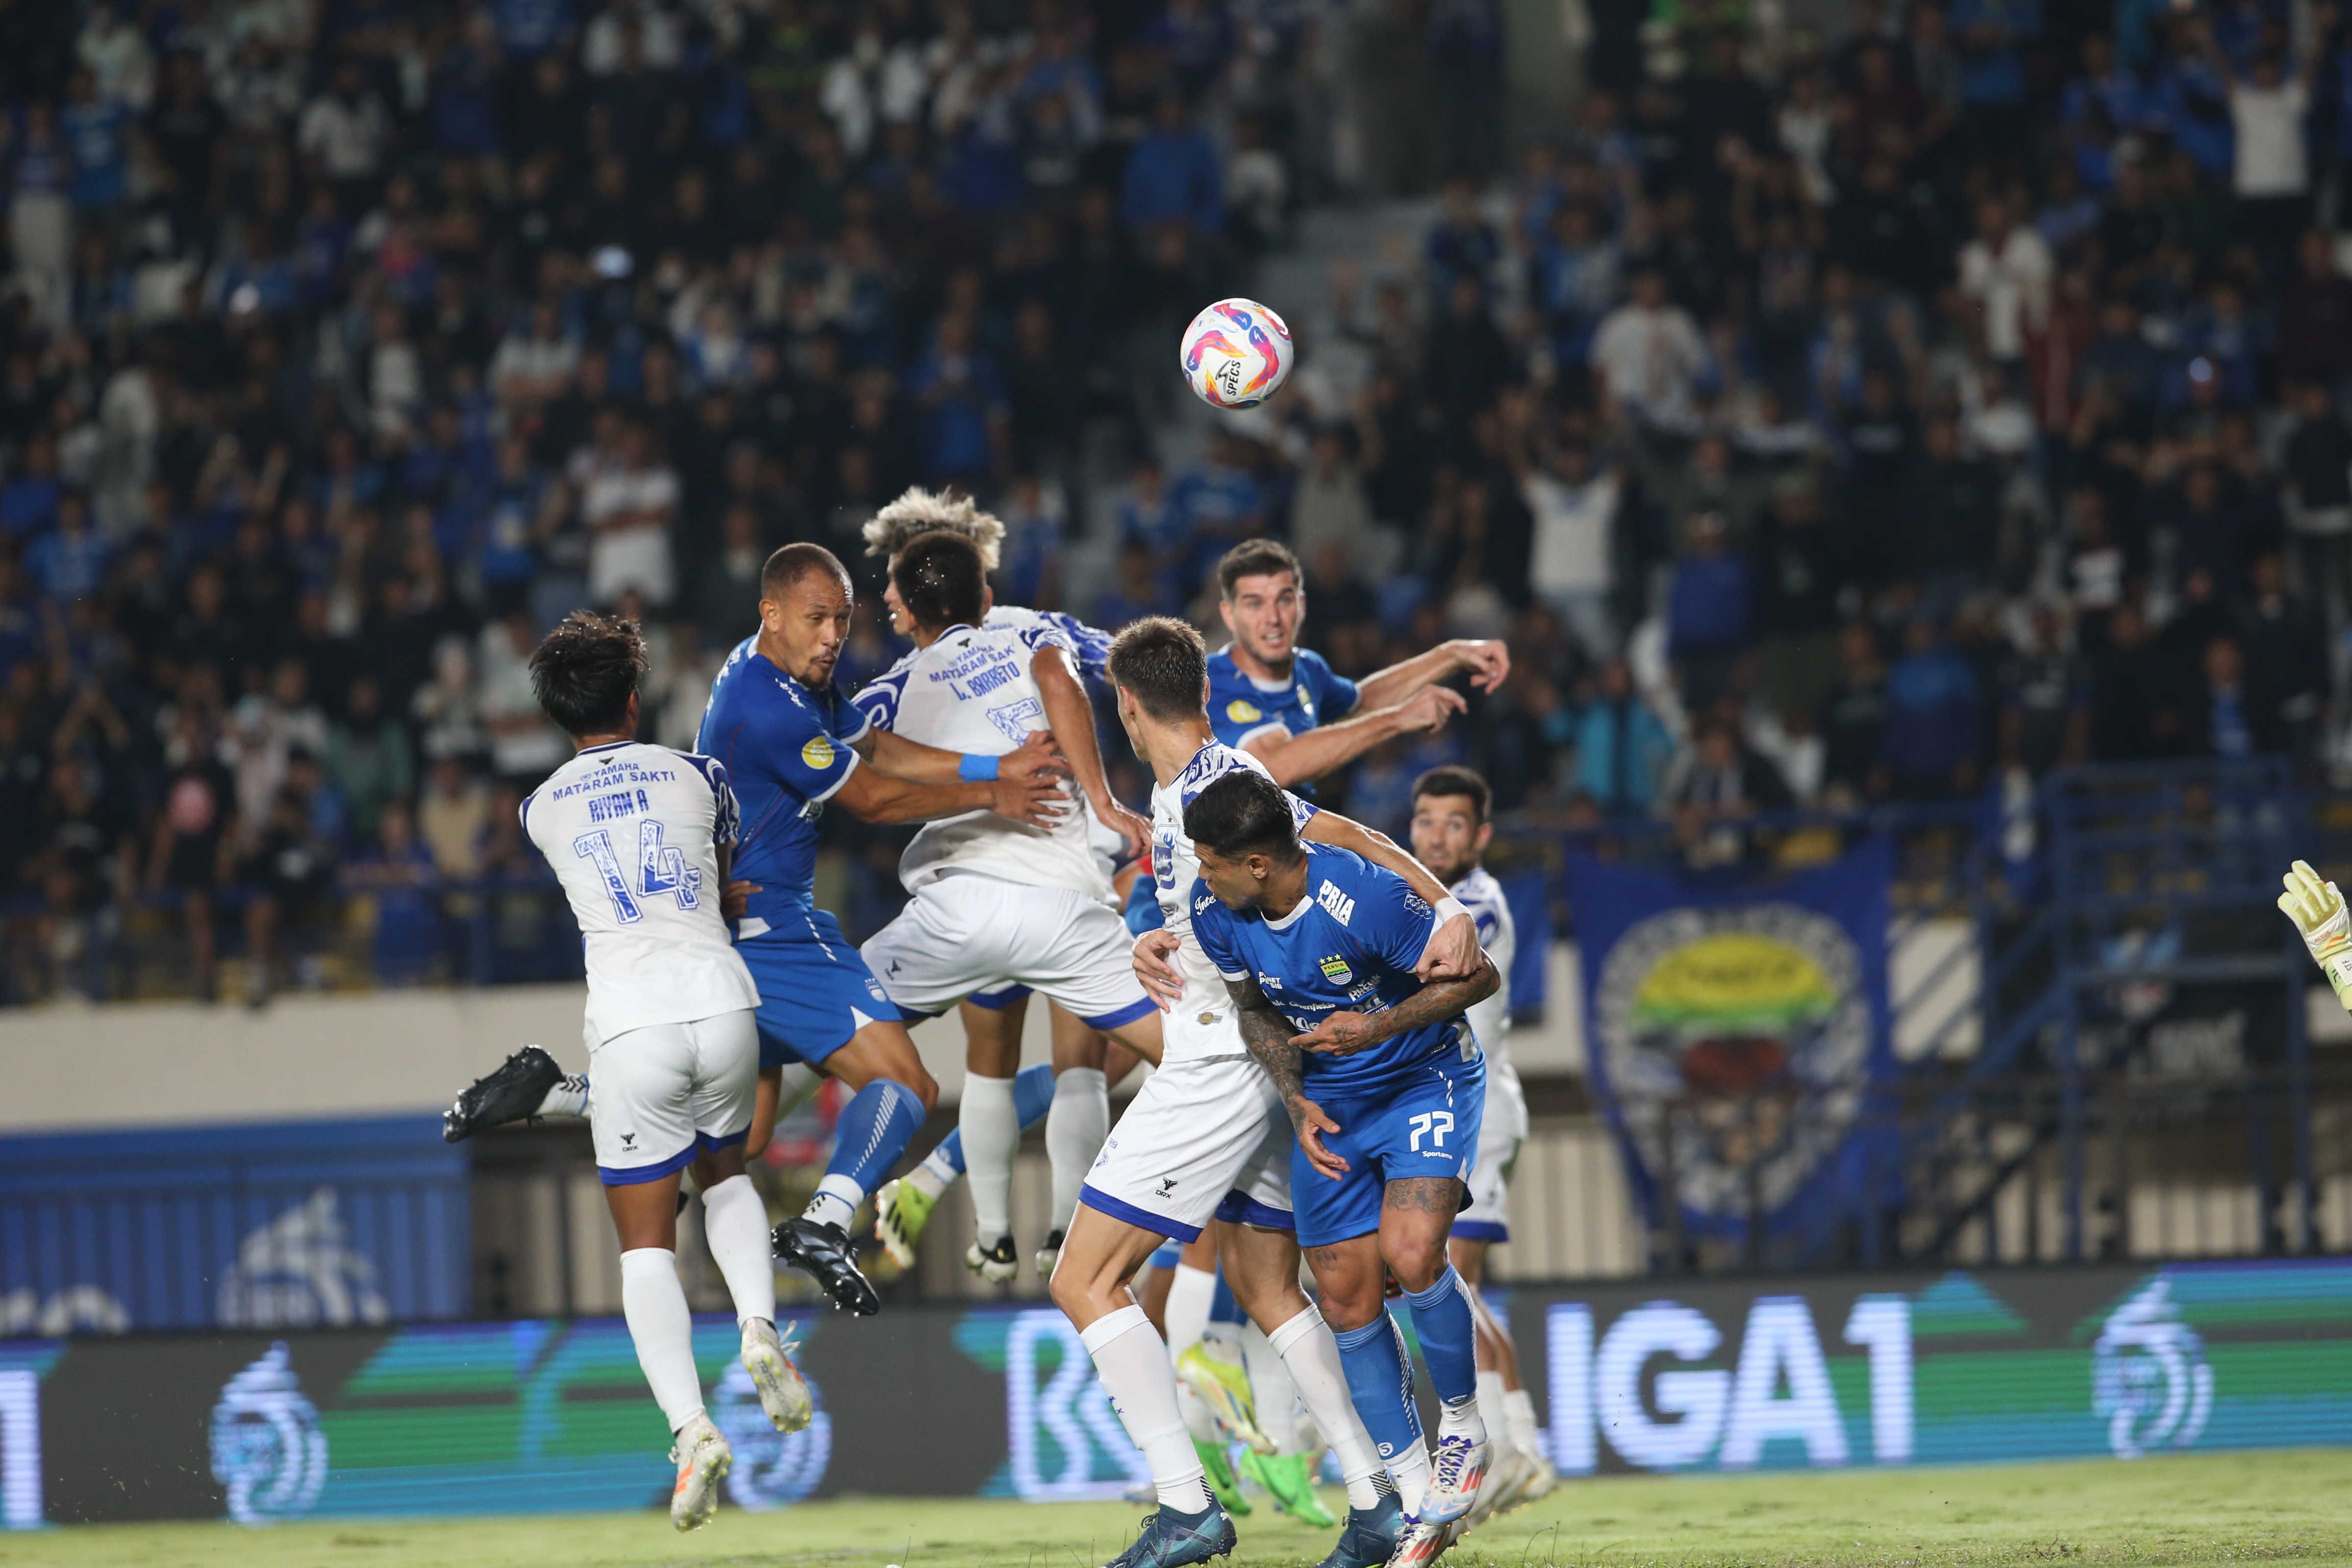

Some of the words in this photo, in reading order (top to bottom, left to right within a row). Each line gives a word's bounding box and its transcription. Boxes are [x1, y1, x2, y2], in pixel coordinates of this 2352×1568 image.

[1227, 360, 1241, 396] SPECS
[955, 644, 995, 663] YAMAHA
[950, 682, 971, 701] L.
[969, 662, 1020, 698] BARRETO
[553, 774, 624, 801] MATARAM
[630, 771, 676, 782] SAKTI
[594, 763, 640, 777] YAMAHA
[588, 792, 634, 823] RIYAN
[637, 789, 649, 813] A
[574, 819, 702, 924] 14
[1319, 878, 1355, 920] PRIA
[1330, 909, 1349, 927] SELERA
[1409, 1111, 1454, 1152] 77
[1422, 1150, 1453, 1160] Sportama
[1155, 1190, 1172, 1199] DRX
[1535, 1291, 1915, 1476] IGA1
